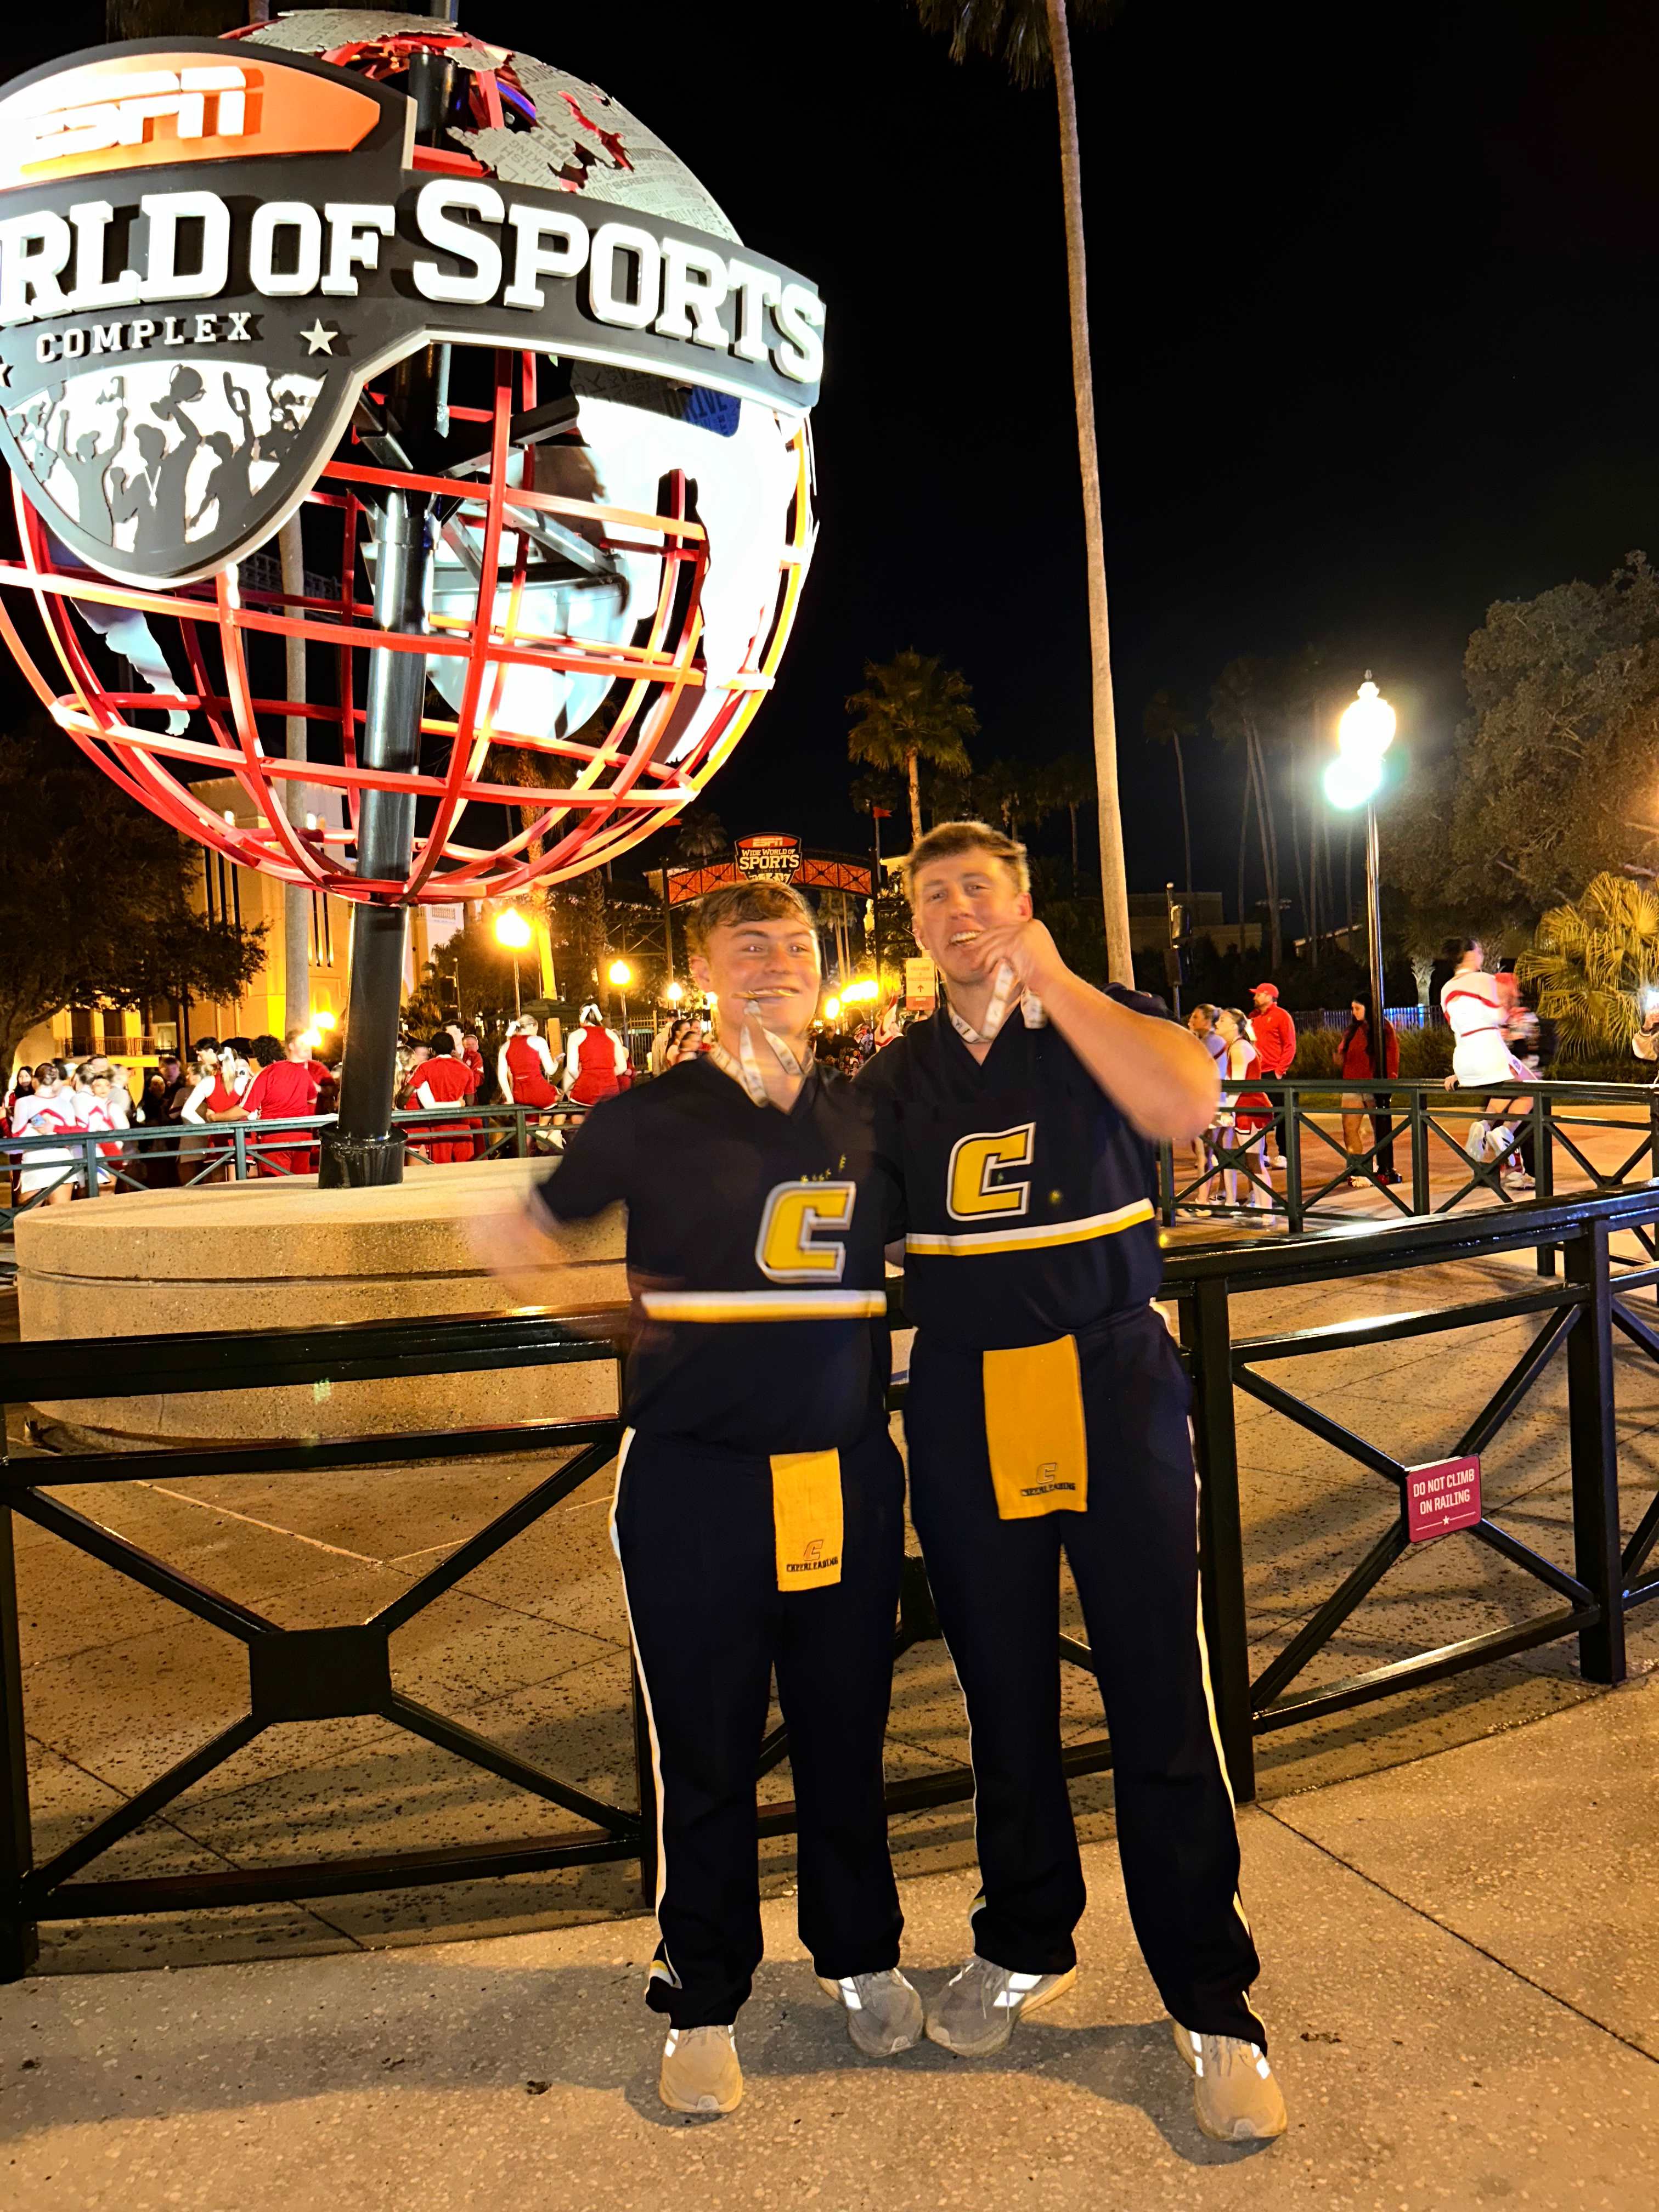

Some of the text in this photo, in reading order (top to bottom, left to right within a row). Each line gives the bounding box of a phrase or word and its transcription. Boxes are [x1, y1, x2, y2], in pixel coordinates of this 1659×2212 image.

[250, 201, 395, 297] OF
[413, 179, 824, 383] SPORTS
[36, 312, 252, 363] COMPLEX
[753, 837, 783, 847] ESPN
[739, 854, 799, 870] SPORTS
[946, 1122, 1036, 1222] C
[755, 1181, 856, 1283] C
[1413, 1469, 1475, 1497] DO NOT CLIMB
[1420, 1489, 1470, 1515] ON RAILING
[803, 1539, 824, 1561] C
[786, 1556, 839, 1572] CHEERLEADING
